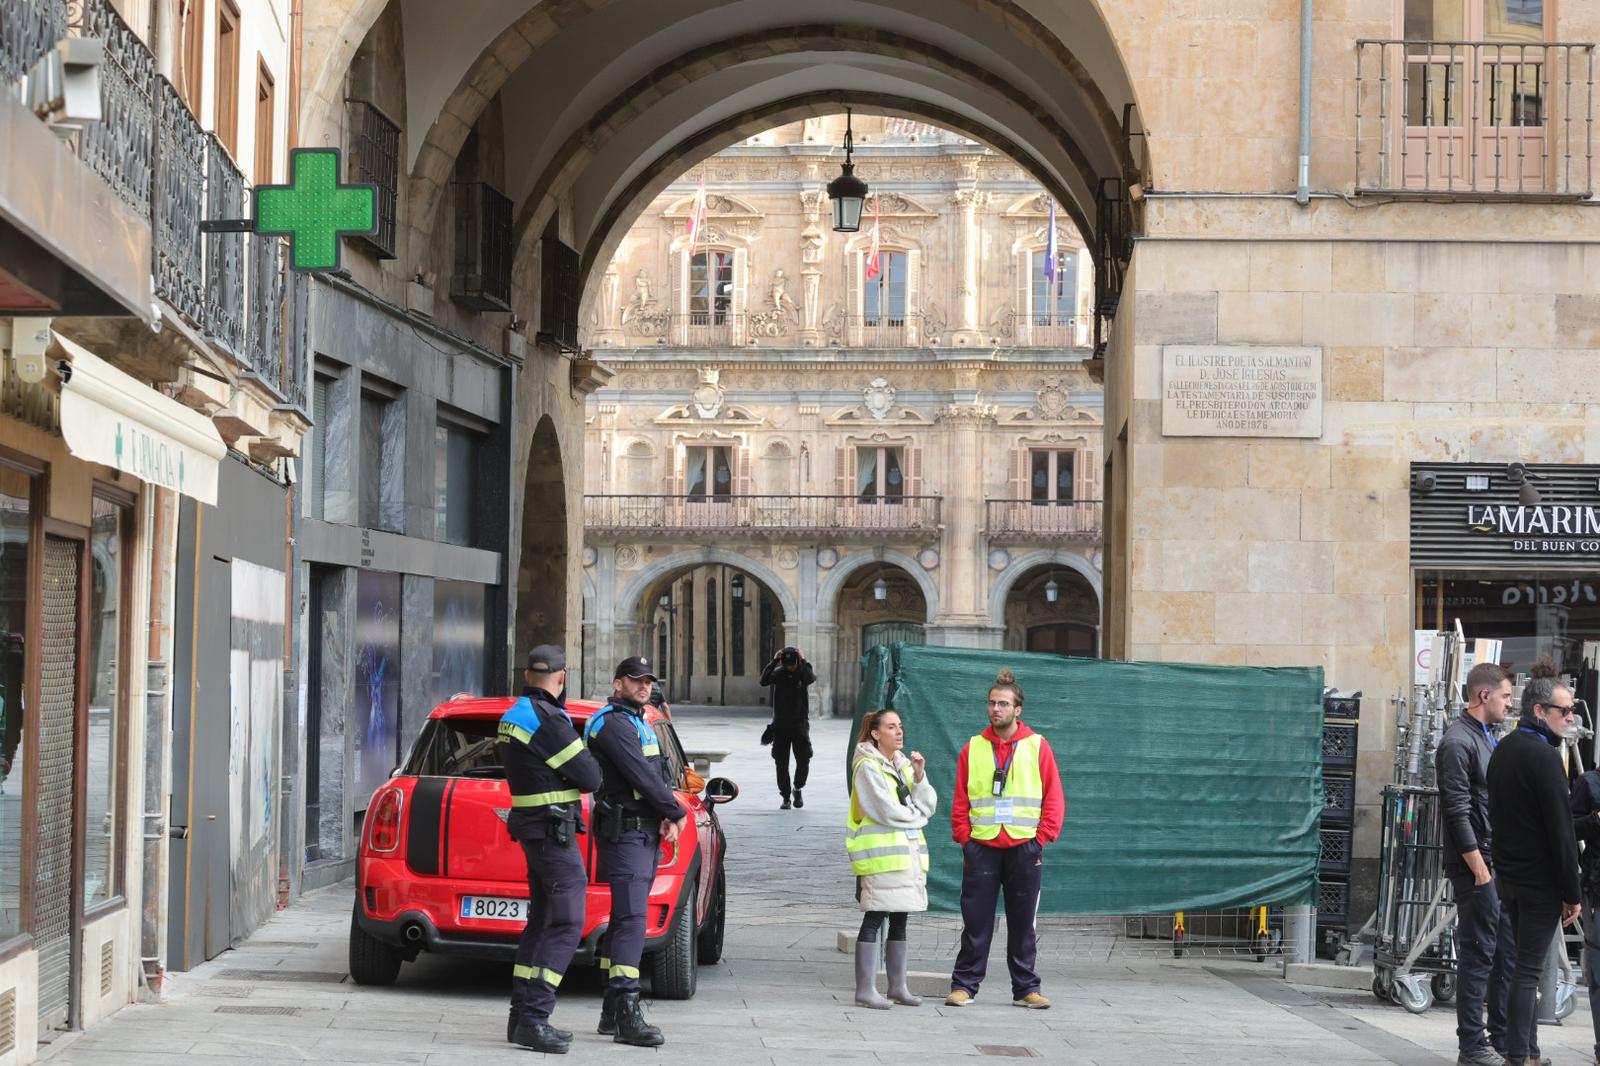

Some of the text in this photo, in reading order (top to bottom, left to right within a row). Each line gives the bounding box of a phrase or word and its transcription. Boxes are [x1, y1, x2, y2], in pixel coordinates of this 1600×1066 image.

[1175, 354, 1312, 369] EL ILUSTRE POETA SALMANTINO
[1241, 367, 1287, 381] IGLESIAS
[1167, 390, 1317, 401] LA TESTAMENTARIA DE SU SOBRINO
[1176, 400, 1309, 411] EL PRESBITERO DON ARCADIO
[1186, 410, 1298, 420] LE DEDICA ESTA MEMORIA
[1234, 420, 1247, 430] DE
[1514, 541, 1537, 551] DEL
[1542, 541, 1575, 551] BUEN
[475, 899, 519, 918] 8023
